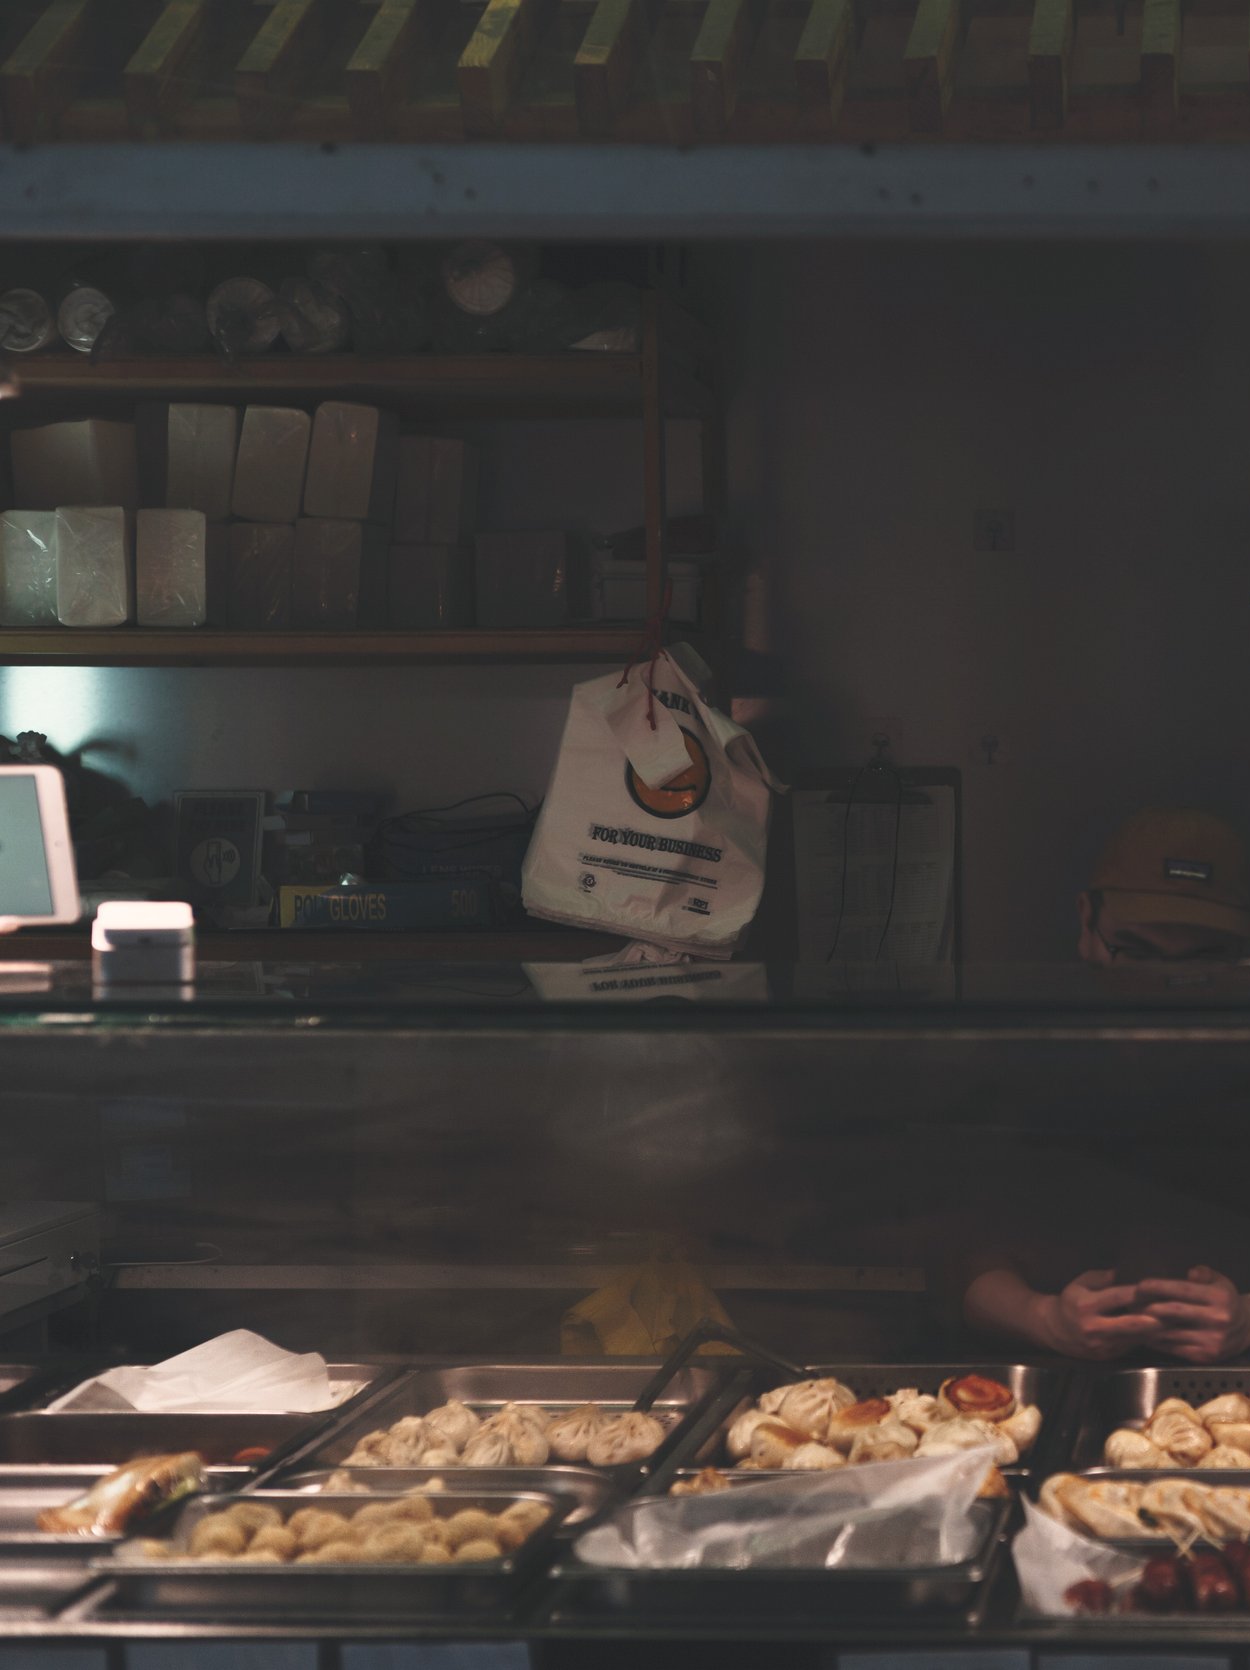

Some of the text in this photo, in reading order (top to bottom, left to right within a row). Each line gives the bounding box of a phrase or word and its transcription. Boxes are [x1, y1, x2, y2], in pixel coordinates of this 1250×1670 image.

[592, 826, 723, 863] FOR YOUR BUSINESS
[329, 893, 388, 921] GLOVES
[450, 889, 478, 917] 500
